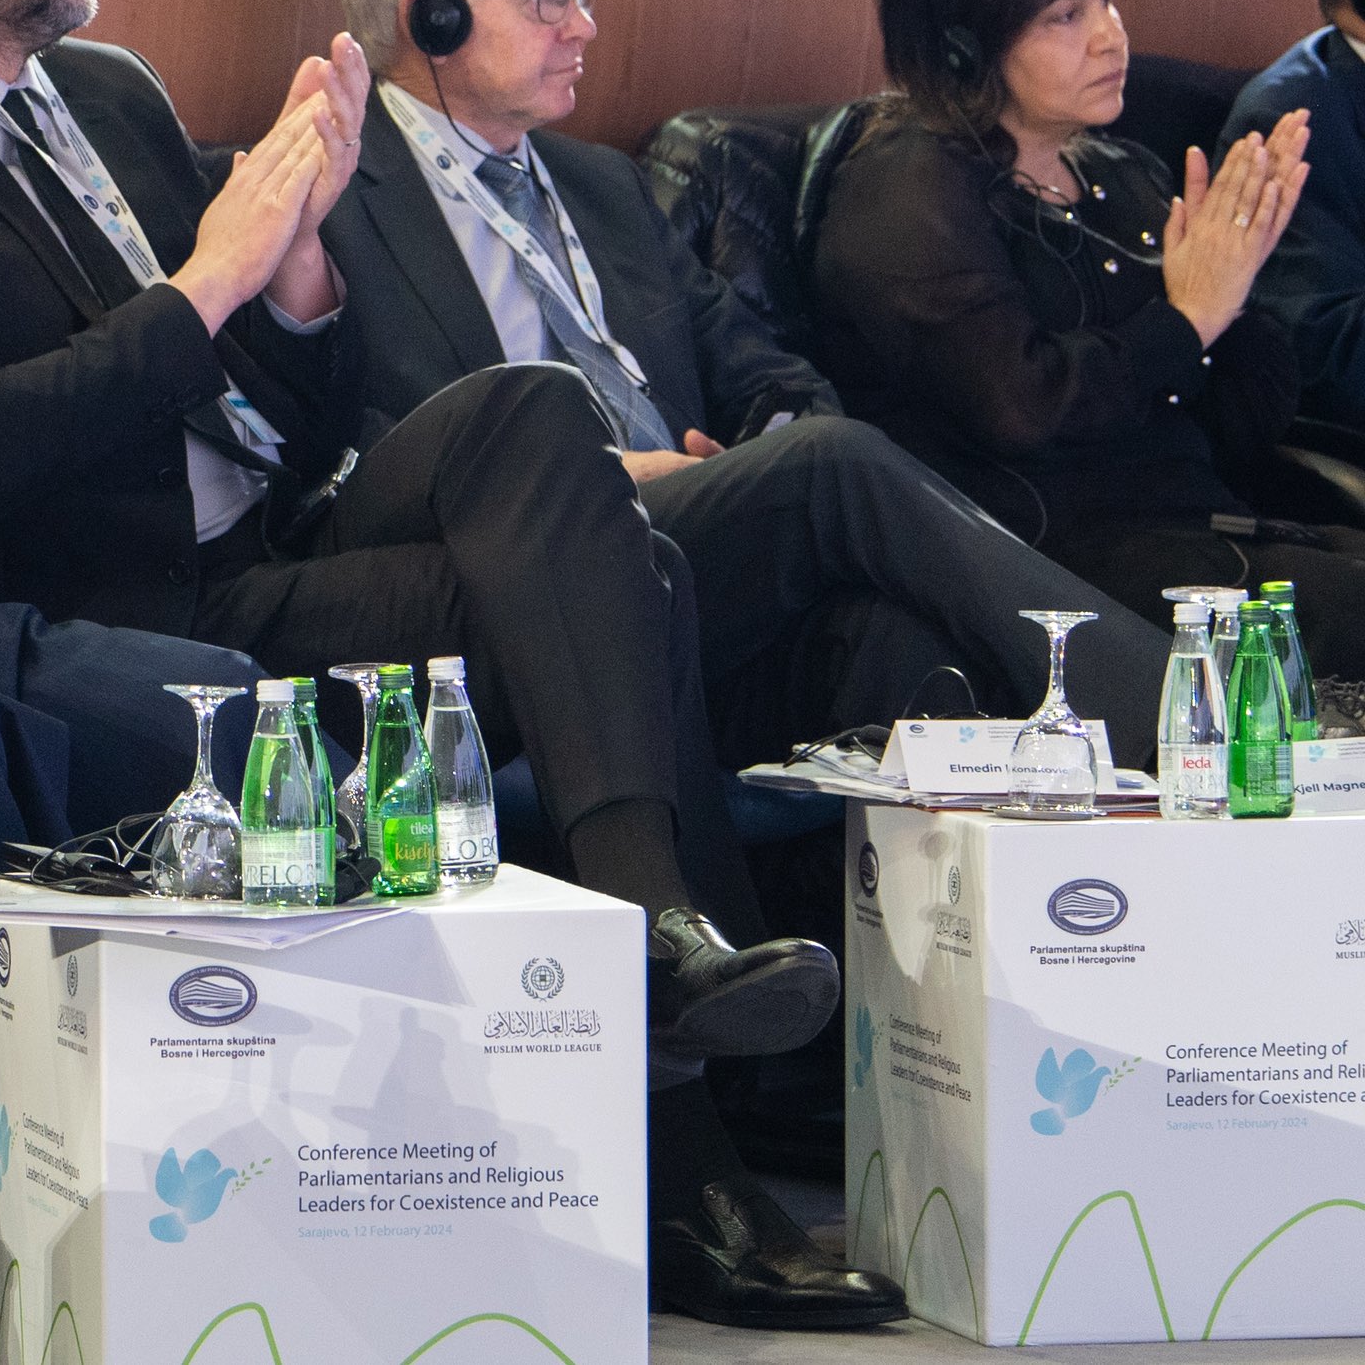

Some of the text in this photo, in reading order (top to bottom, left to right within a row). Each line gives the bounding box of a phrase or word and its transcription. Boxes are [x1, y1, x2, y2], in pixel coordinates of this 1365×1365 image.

[950, 763, 1002, 774] Elmedin
[1183, 756, 1212, 770] leda
[1294, 781, 1365, 795] Kjell Magne
[1030, 943, 1145, 955] Parlamentarna skupština
[1040, 955, 1136, 966] Bosne i Hercegovine
[150, 1036, 276, 1047] Parlamentarna skupština
[484, 1043, 602, 1054] MUSLIM WORLD LEAGUE
[161, 1048, 265, 1059] Bosne i Hercegovine
[1166, 1040, 1349, 1060] Conference Meeting of
[1167, 1067, 1299, 1083] Parliamentarians
[1304, 1064, 1333, 1080] and
[1167, 1092, 1227, 1107] Leaders
[1232, 1090, 1255, 1105] for
[1259, 1089, 1356, 1105] Coexistence
[1166, 1117, 1307, 1132] Sarajevo, 12 February 2024
[298, 1141, 498, 1162] Conference Meeting of
[299, 1167, 564, 1186] Parliamentarians and Religious
[299, 1192, 599, 1212] Leaders for Coexistence and Peace
[298, 1224, 452, 1239] Sarajevo, 12 February 2024
